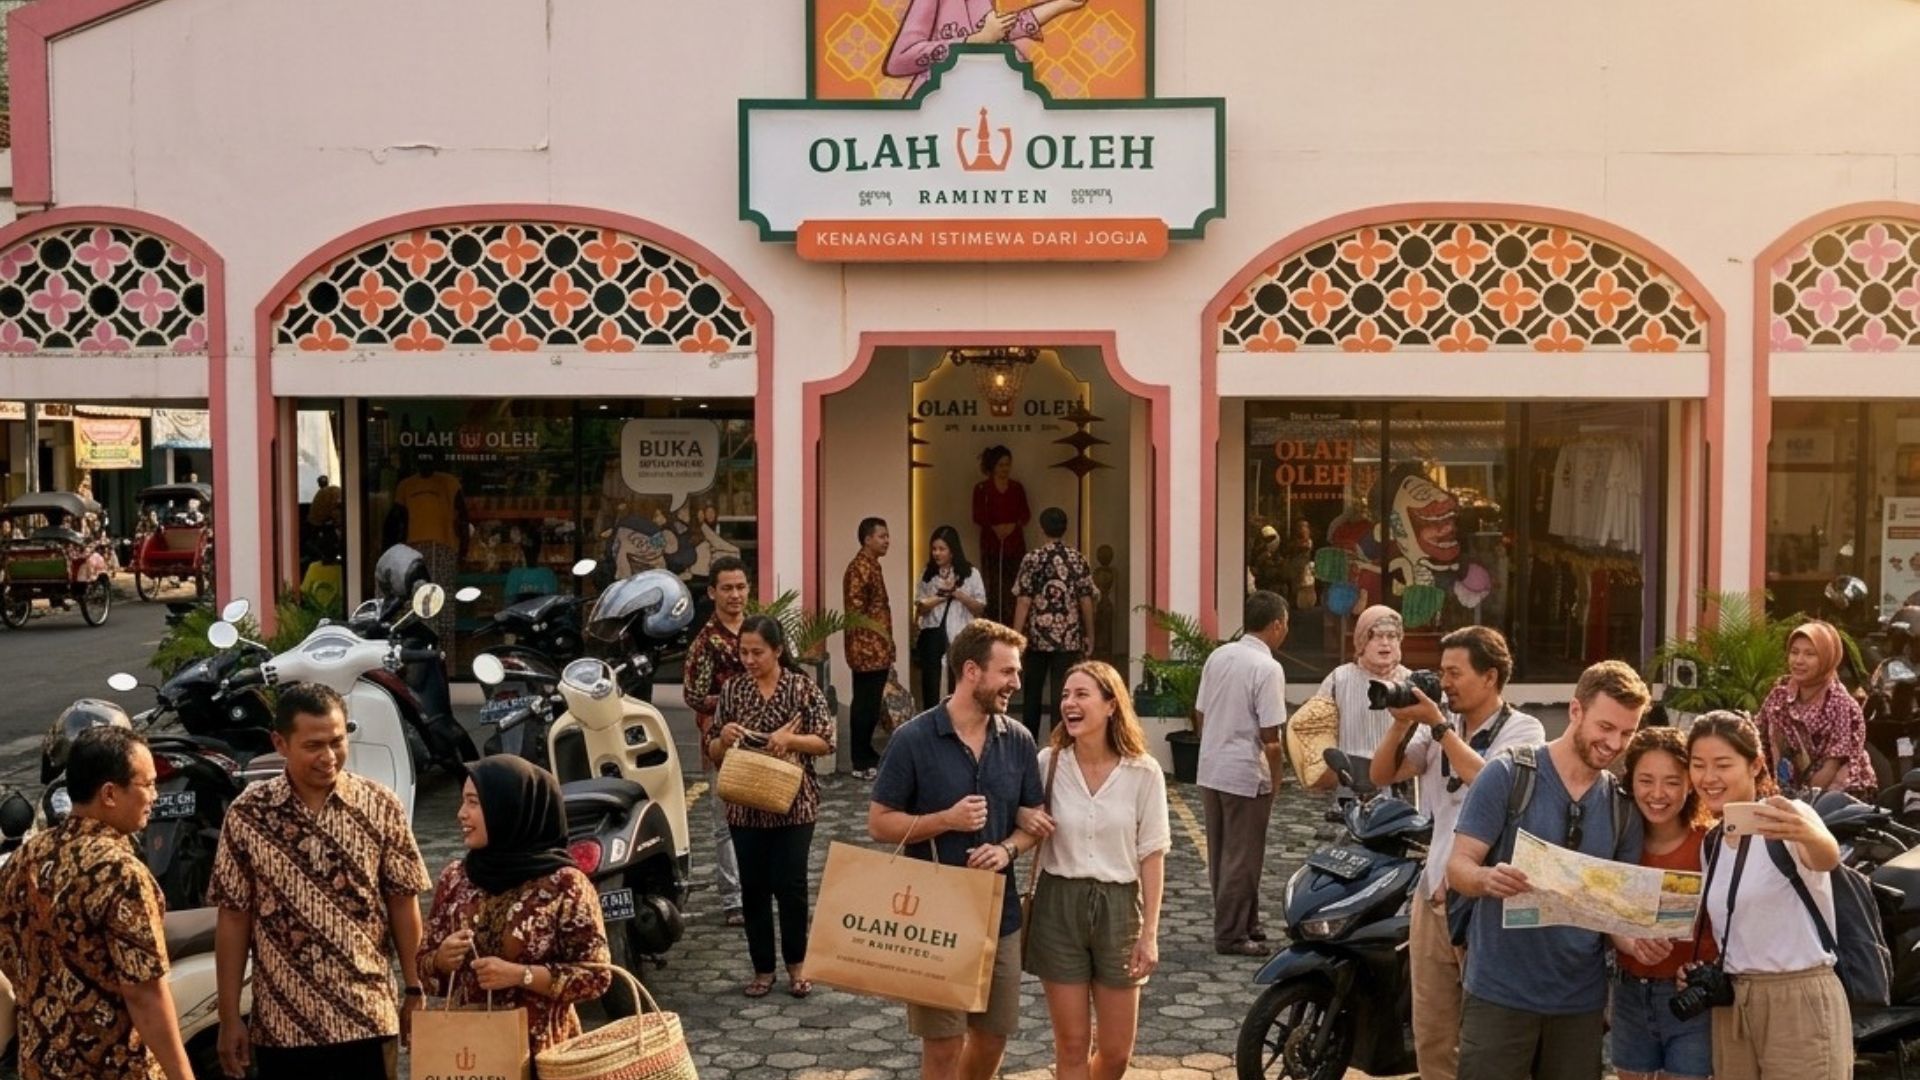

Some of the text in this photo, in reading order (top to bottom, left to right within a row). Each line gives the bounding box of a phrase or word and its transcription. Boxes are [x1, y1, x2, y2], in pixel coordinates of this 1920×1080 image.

[809, 133, 1155, 172] OLAH OLEH
[919, 190, 1047, 204] RAMINTEN
[816, 231, 1148, 246] KENANGAN ISTIMEWA DARI JOGJA
[917, 400, 977, 416] OLAH
[400, 431, 539, 448] OLAH OLEH
[640, 440, 703, 457] BUKA
[904, 924, 958, 949] OLEH
